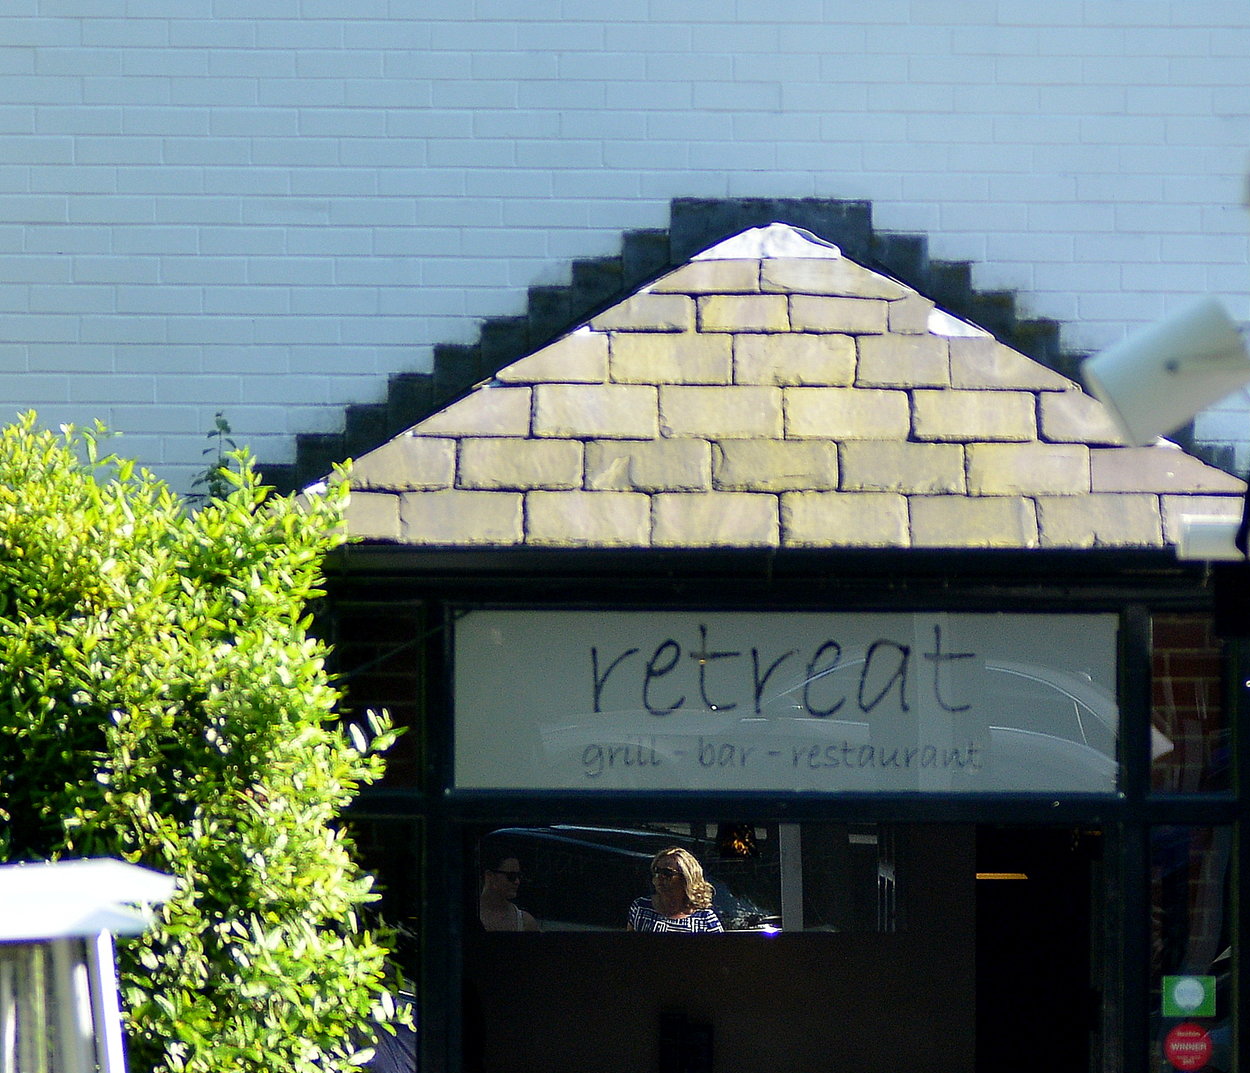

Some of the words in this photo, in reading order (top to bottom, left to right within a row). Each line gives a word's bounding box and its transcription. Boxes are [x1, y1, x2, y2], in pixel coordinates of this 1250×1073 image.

[589, 624, 977, 718] retreat
[581, 738, 662, 777] grill
[698, 738, 755, 771] bar
[791, 740, 983, 771] restaurant
